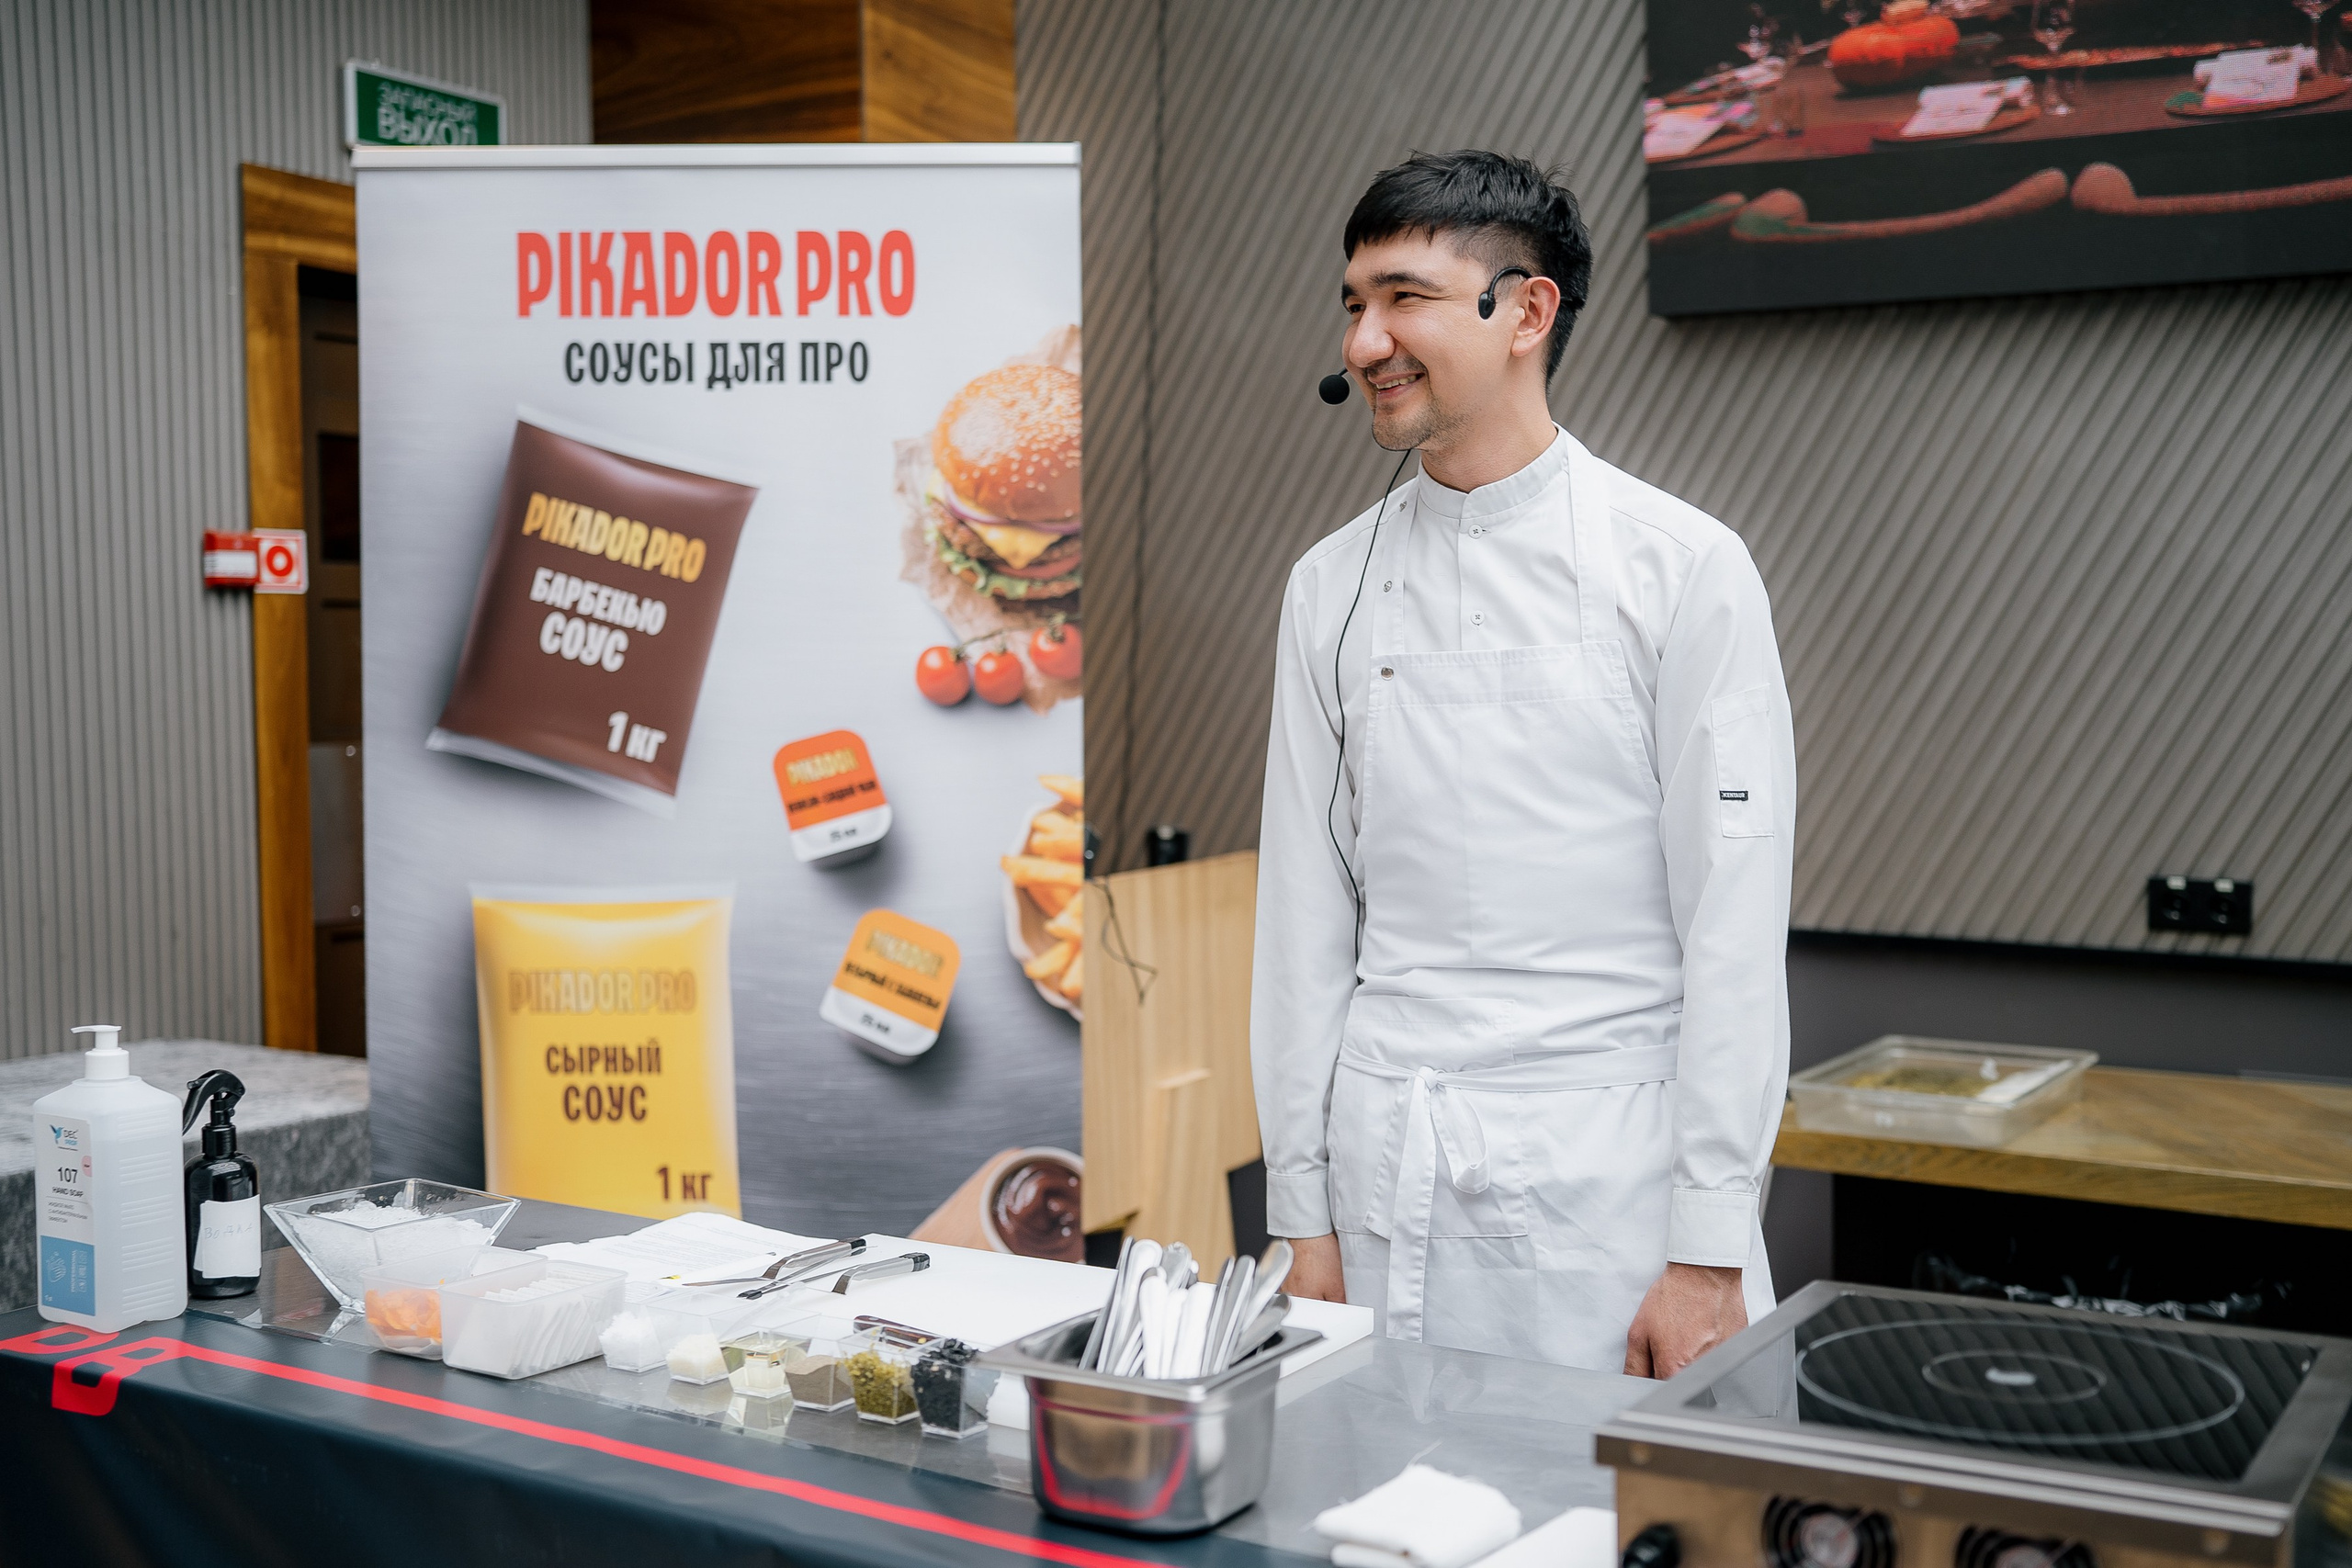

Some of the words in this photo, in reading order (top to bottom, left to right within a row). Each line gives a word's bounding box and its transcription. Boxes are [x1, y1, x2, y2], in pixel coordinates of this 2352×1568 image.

[517, 231, 783, 318] PIKADOR
[797, 230, 916, 317] PRO
[564, 341, 695, 384] СОУСЫ
[707, 341, 786, 390] ДЛЯ
[800, 341, 870, 383] ПРО
[522, 491, 650, 569] PIKADOR
[643, 525, 707, 583] PRO
[529, 566, 668, 636] БАРБЕКЬЮ
[539, 611, 629, 672] СОУС
[607, 710, 629, 753] 1
[508, 971, 634, 1014] PIKADOR
[640, 971, 697, 1014] PRO
[546, 1038, 662, 1075] СЫРНЫЙ
[563, 1085, 648, 1122] СОУС
[57, 1167, 78, 1184] 107
[657, 1166, 670, 1201] 1
